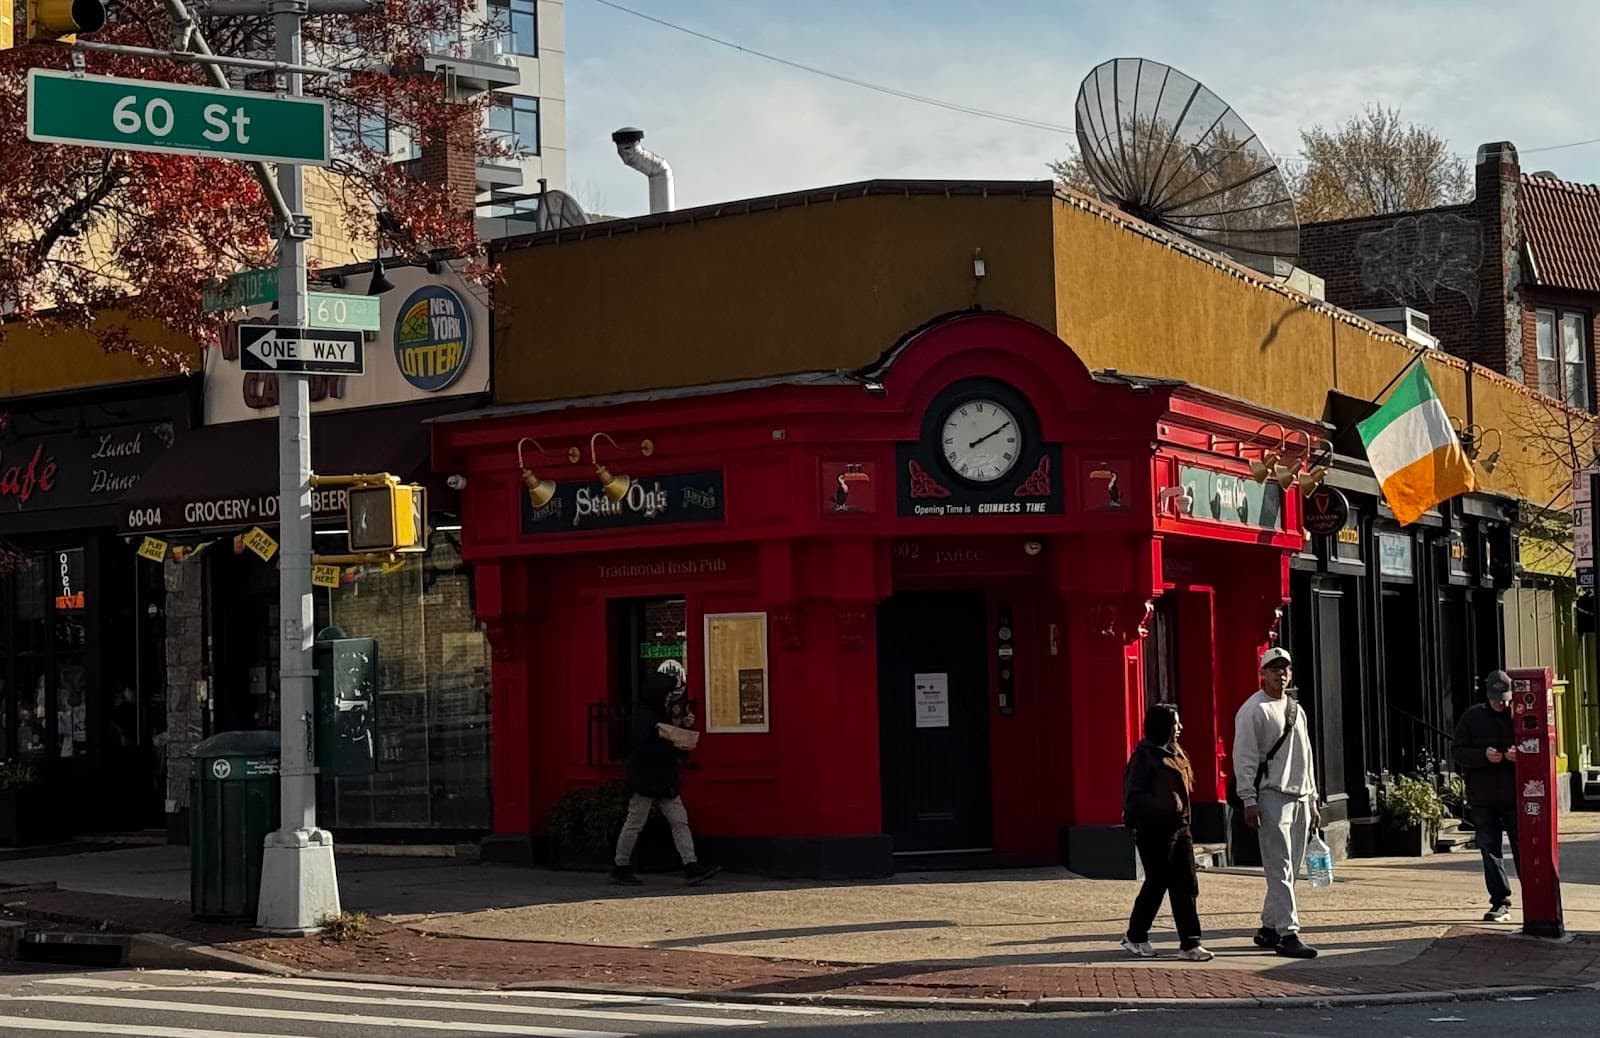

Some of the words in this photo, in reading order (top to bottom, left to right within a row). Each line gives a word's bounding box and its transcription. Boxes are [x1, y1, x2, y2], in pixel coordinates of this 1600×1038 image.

[113, 95, 174, 137] 60
[202, 104, 250, 145] St
[203, 274, 265, 309] SIDE
[317, 299, 347, 323] 60
[430, 298, 454, 316] NEW
[431, 316, 461, 340] YORK
[260, 340, 297, 358] ONE
[313, 342, 347, 361] WAY
[400, 341, 463, 377] LOTTERY
[91, 432, 143, 459] Lunch
[0, 441, 57, 504] afé
[90, 469, 142, 493] Dinne
[128, 508, 161, 528] 60-04
[185, 498, 251, 523] GROCERY
[259, 496, 280, 516] LO
[312, 489, 347, 512] BEER
[914, 504, 945, 516] Opening
[946, 504, 963, 514] Time
[964, 504, 972, 514] is
[977, 503, 1021, 513] GUINNESS
[1025, 502, 1046, 513] TIME
[250, 538, 270, 559] HERE
[253, 531, 273, 549] PLAY
[316, 566, 335, 577] PLAY
[598, 561, 665, 579] Traditional
[668, 559, 697, 576] Irish
[700, 557, 726, 573] Pub
